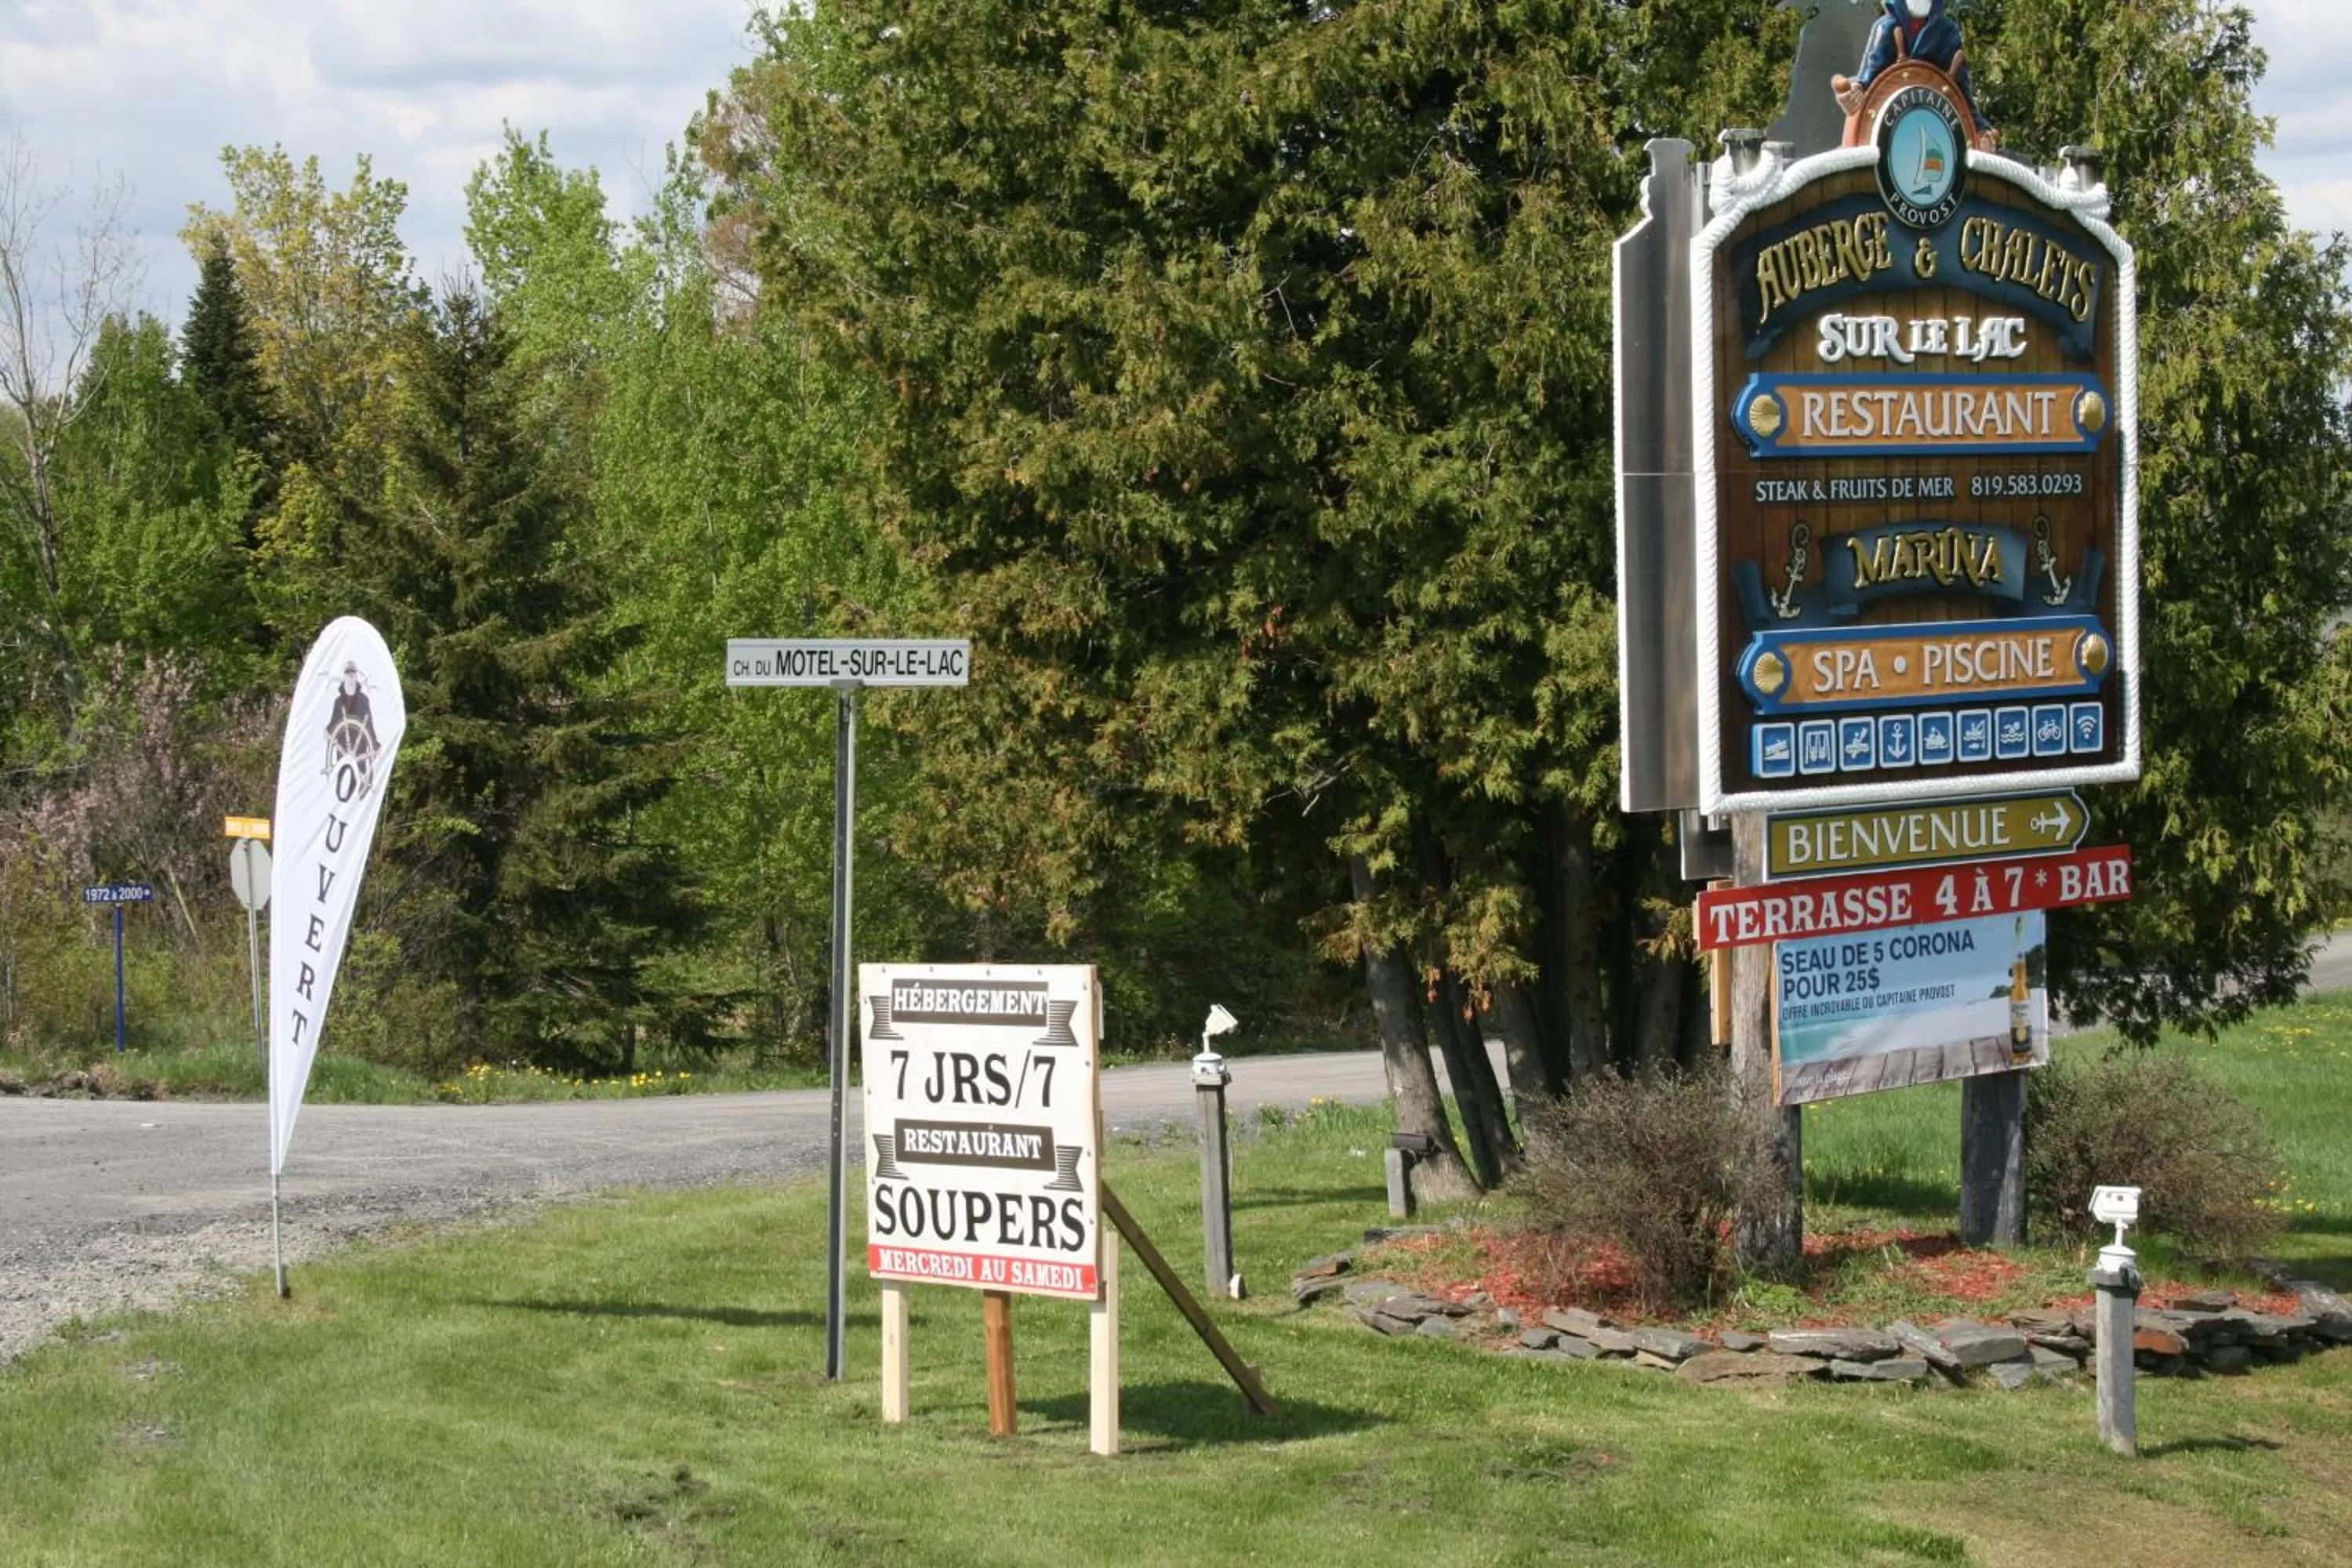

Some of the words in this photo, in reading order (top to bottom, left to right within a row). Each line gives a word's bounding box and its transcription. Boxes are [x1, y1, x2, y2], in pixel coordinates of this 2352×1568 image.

[1883, 89, 1959, 131] CAPITAINE
[1889, 193, 1957, 225] PROVOST
[1756, 212, 1893, 322] AUBERGE
[1915, 238, 1938, 278] &
[1961, 216, 2096, 322] CHALETS
[1818, 314, 1915, 363] SUR
[1909, 318, 1948, 354] LE
[1955, 316, 2027, 362] LAC
[1802, 390, 2057, 438] RESTAURANT
[1755, 480, 1808, 502] STEAK
[1812, 481, 1828, 500] &
[1831, 477, 1886, 499] FRUITS
[1892, 477, 1912, 497] DE
[1918, 477, 1955, 497] MER
[1971, 474, 2082, 496] 819.583.0293
[1846, 527, 2005, 590] MARINA
[755, 660, 771, 676] DU
[775, 649, 964, 677] MOTEL-SUR-LE-LAC
[1813, 649, 1879, 694] SPA
[1922, 637, 2055, 686] PISCINE
[1788, 807, 2010, 865] BIENVENUE
[85, 888, 111, 901] 1972
[118, 887, 143, 900] 2000
[291, 763, 358, 1046] OUVERT
[1709, 882, 1913, 944] TERRASSE
[1935, 874, 1958, 916] 4
[1970, 867, 1994, 913] À
[2004, 866, 2025, 907] 7
[2058, 858, 2131, 902] BAR
[1781, 947, 1836, 975] SEAU
[1843, 942, 1869, 967] DE
[1873, 941, 1883, 964] 5
[1889, 929, 1975, 961] CORONA
[893, 982, 1048, 1015] HÉBERGEMENT
[1782, 1005, 1808, 1020] OFFRE
[1810, 997, 1860, 1017] INCROYABLE
[1862, 997, 1874, 1010] DU
[1876, 989, 1917, 1007] CAPITAINE
[1918, 984, 1955, 1002] PROVOST
[1784, 973, 1840, 1000] POUR
[1845, 965, 1881, 993] 25$
[890, 1050, 909, 1100] 7
[903, 1127, 1043, 1160] RESTAURANT
[875, 1183, 1085, 1252] SOUPERS
[878, 1248, 974, 1280] MERCREDI
[979, 1258, 1007, 1282] AU
[1011, 1262, 1084, 1290] SAMEDI
